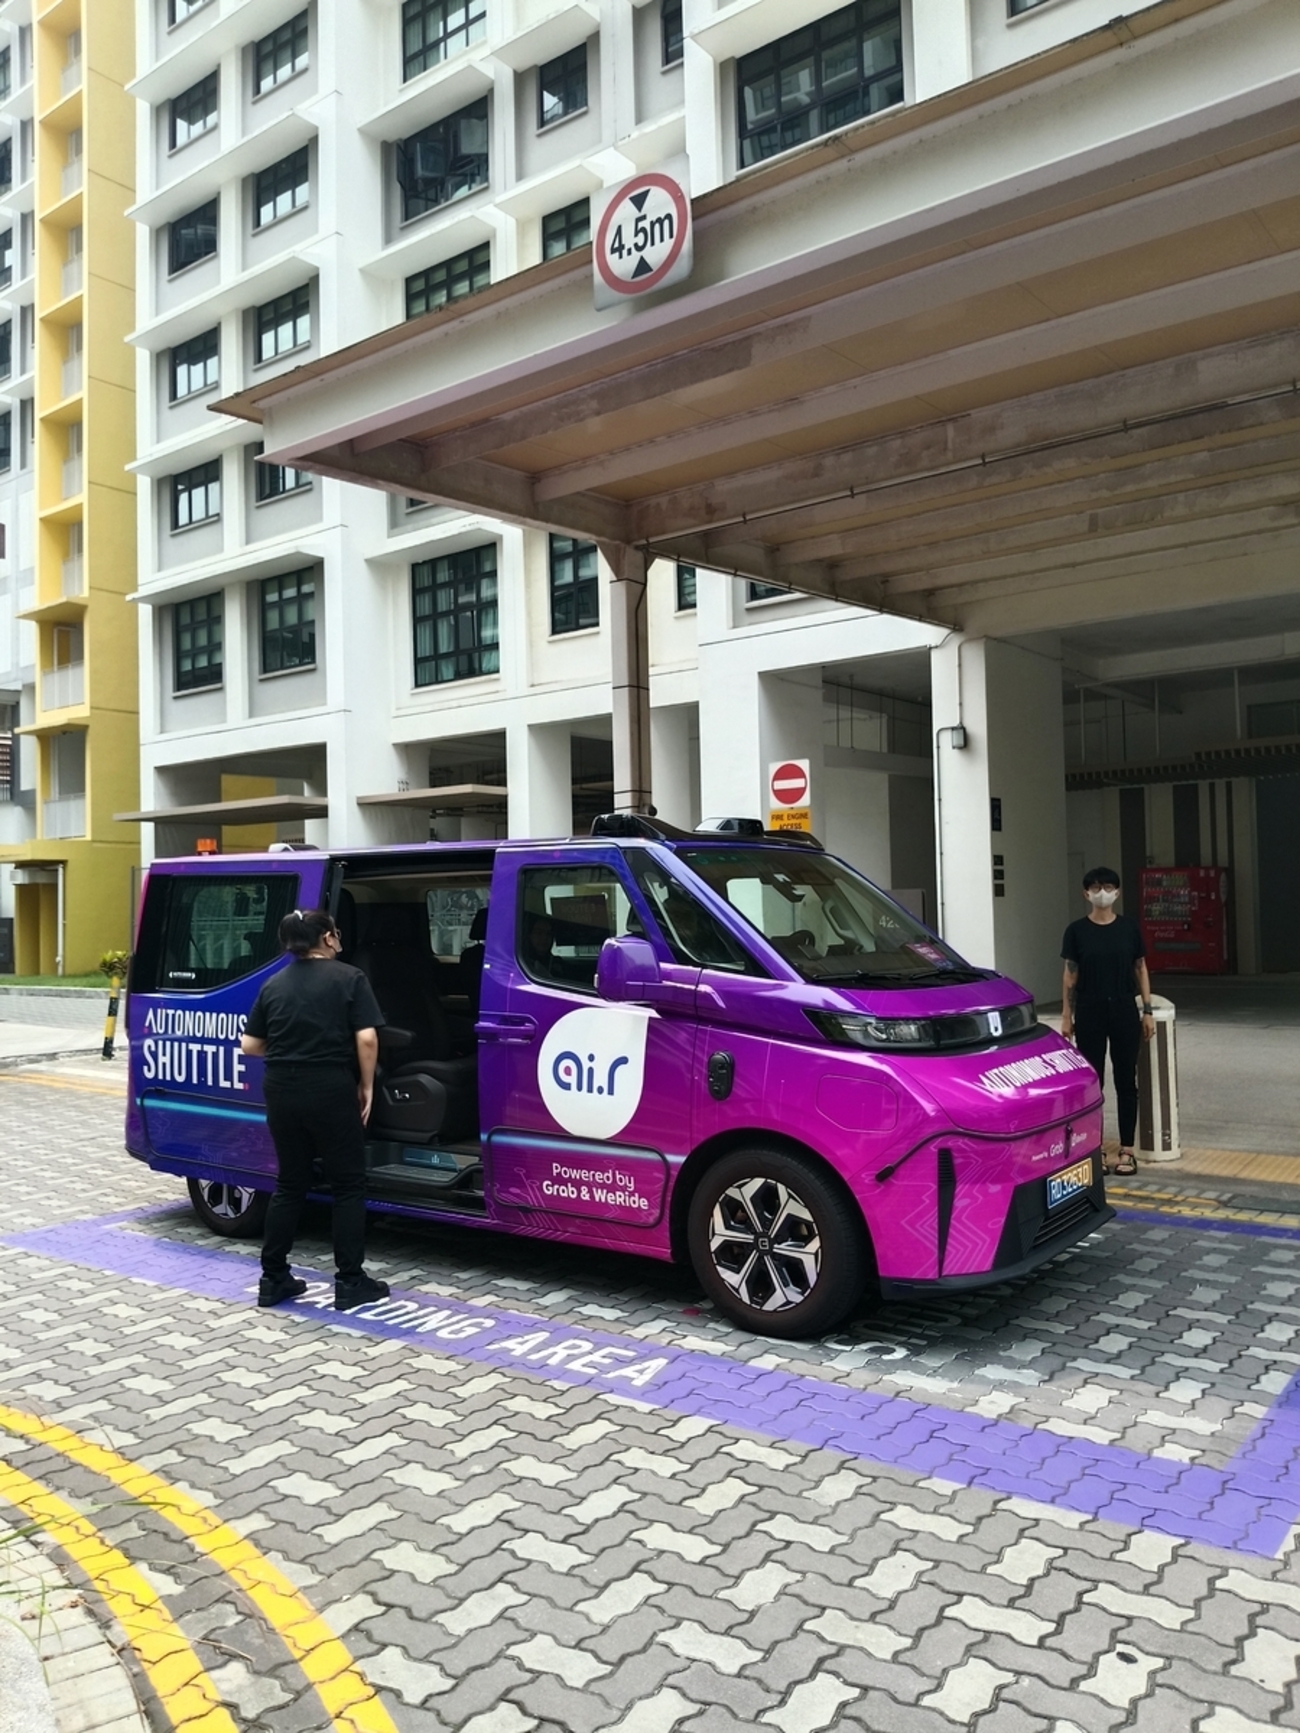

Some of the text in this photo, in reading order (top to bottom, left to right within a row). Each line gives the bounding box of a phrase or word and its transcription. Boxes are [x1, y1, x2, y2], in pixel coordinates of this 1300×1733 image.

[610, 212, 674, 260] 4.5m
[771, 812, 809, 821] FIRE ENGINE
[144, 1007, 248, 1040] AUTONOMOUS
[143, 1038, 247, 1090] SHUTTLE
[552, 1162, 635, 1191] Powered by
[542, 1180, 649, 1210] Grab & WeRide
[486, 1330, 669, 1387] AREA
